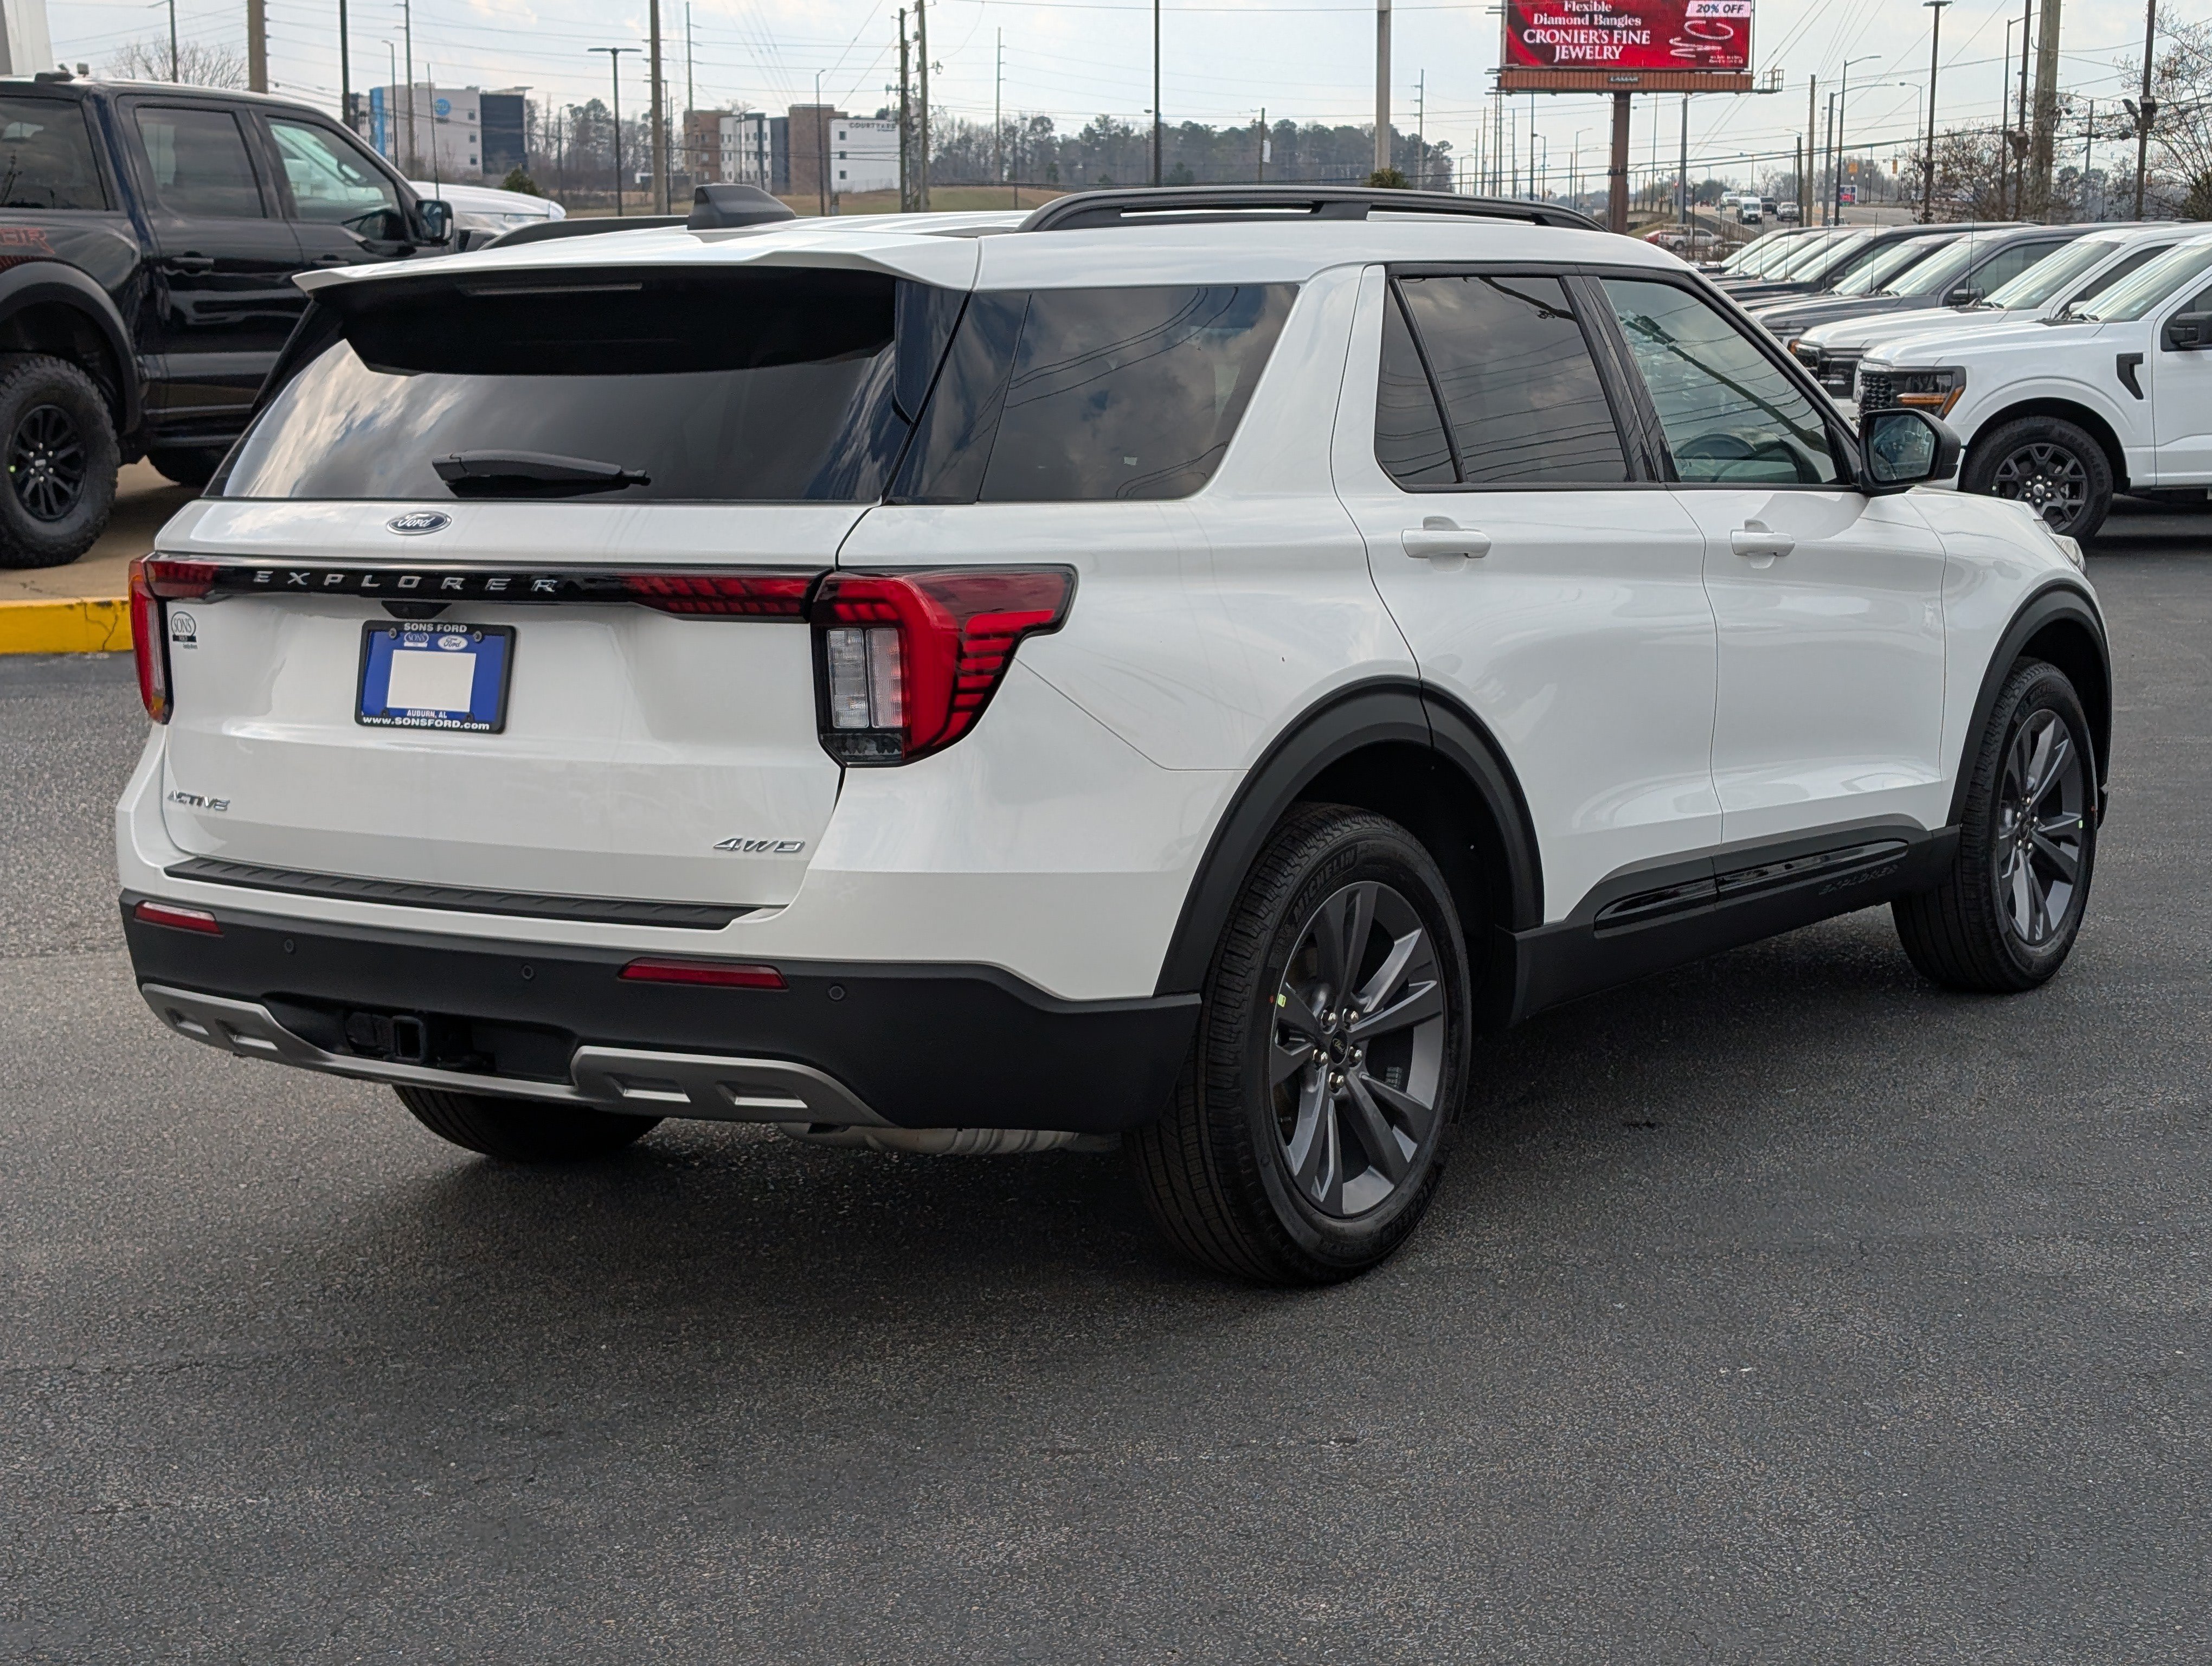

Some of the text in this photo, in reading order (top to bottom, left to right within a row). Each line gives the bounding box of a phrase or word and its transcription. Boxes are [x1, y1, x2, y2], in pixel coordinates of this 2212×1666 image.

[1564, 0, 1612, 12] Flexible
[1696, 4, 1744, 13] 20% OFF
[1534, 13, 1642, 27] Diamond Bangles
[1523, 29, 1650, 44] CRONIER'S FINE
[1553, 45, 1623, 63] JEWELRY
[397, 514, 436, 527] Ford
[253, 570, 558, 593] EXPLORER
[173, 618, 192, 633] SONS
[404, 623, 467, 633] SONS FORD
[443, 637, 461, 648] Ford
[407, 710, 437, 719] AUBURN,
[363, 717, 490, 731] www.SONSFORD.com
[168, 790, 230, 811] ACTIVE
[713, 837, 806, 853] 4WD
[1294, 849, 1356, 921] MICHELIN
